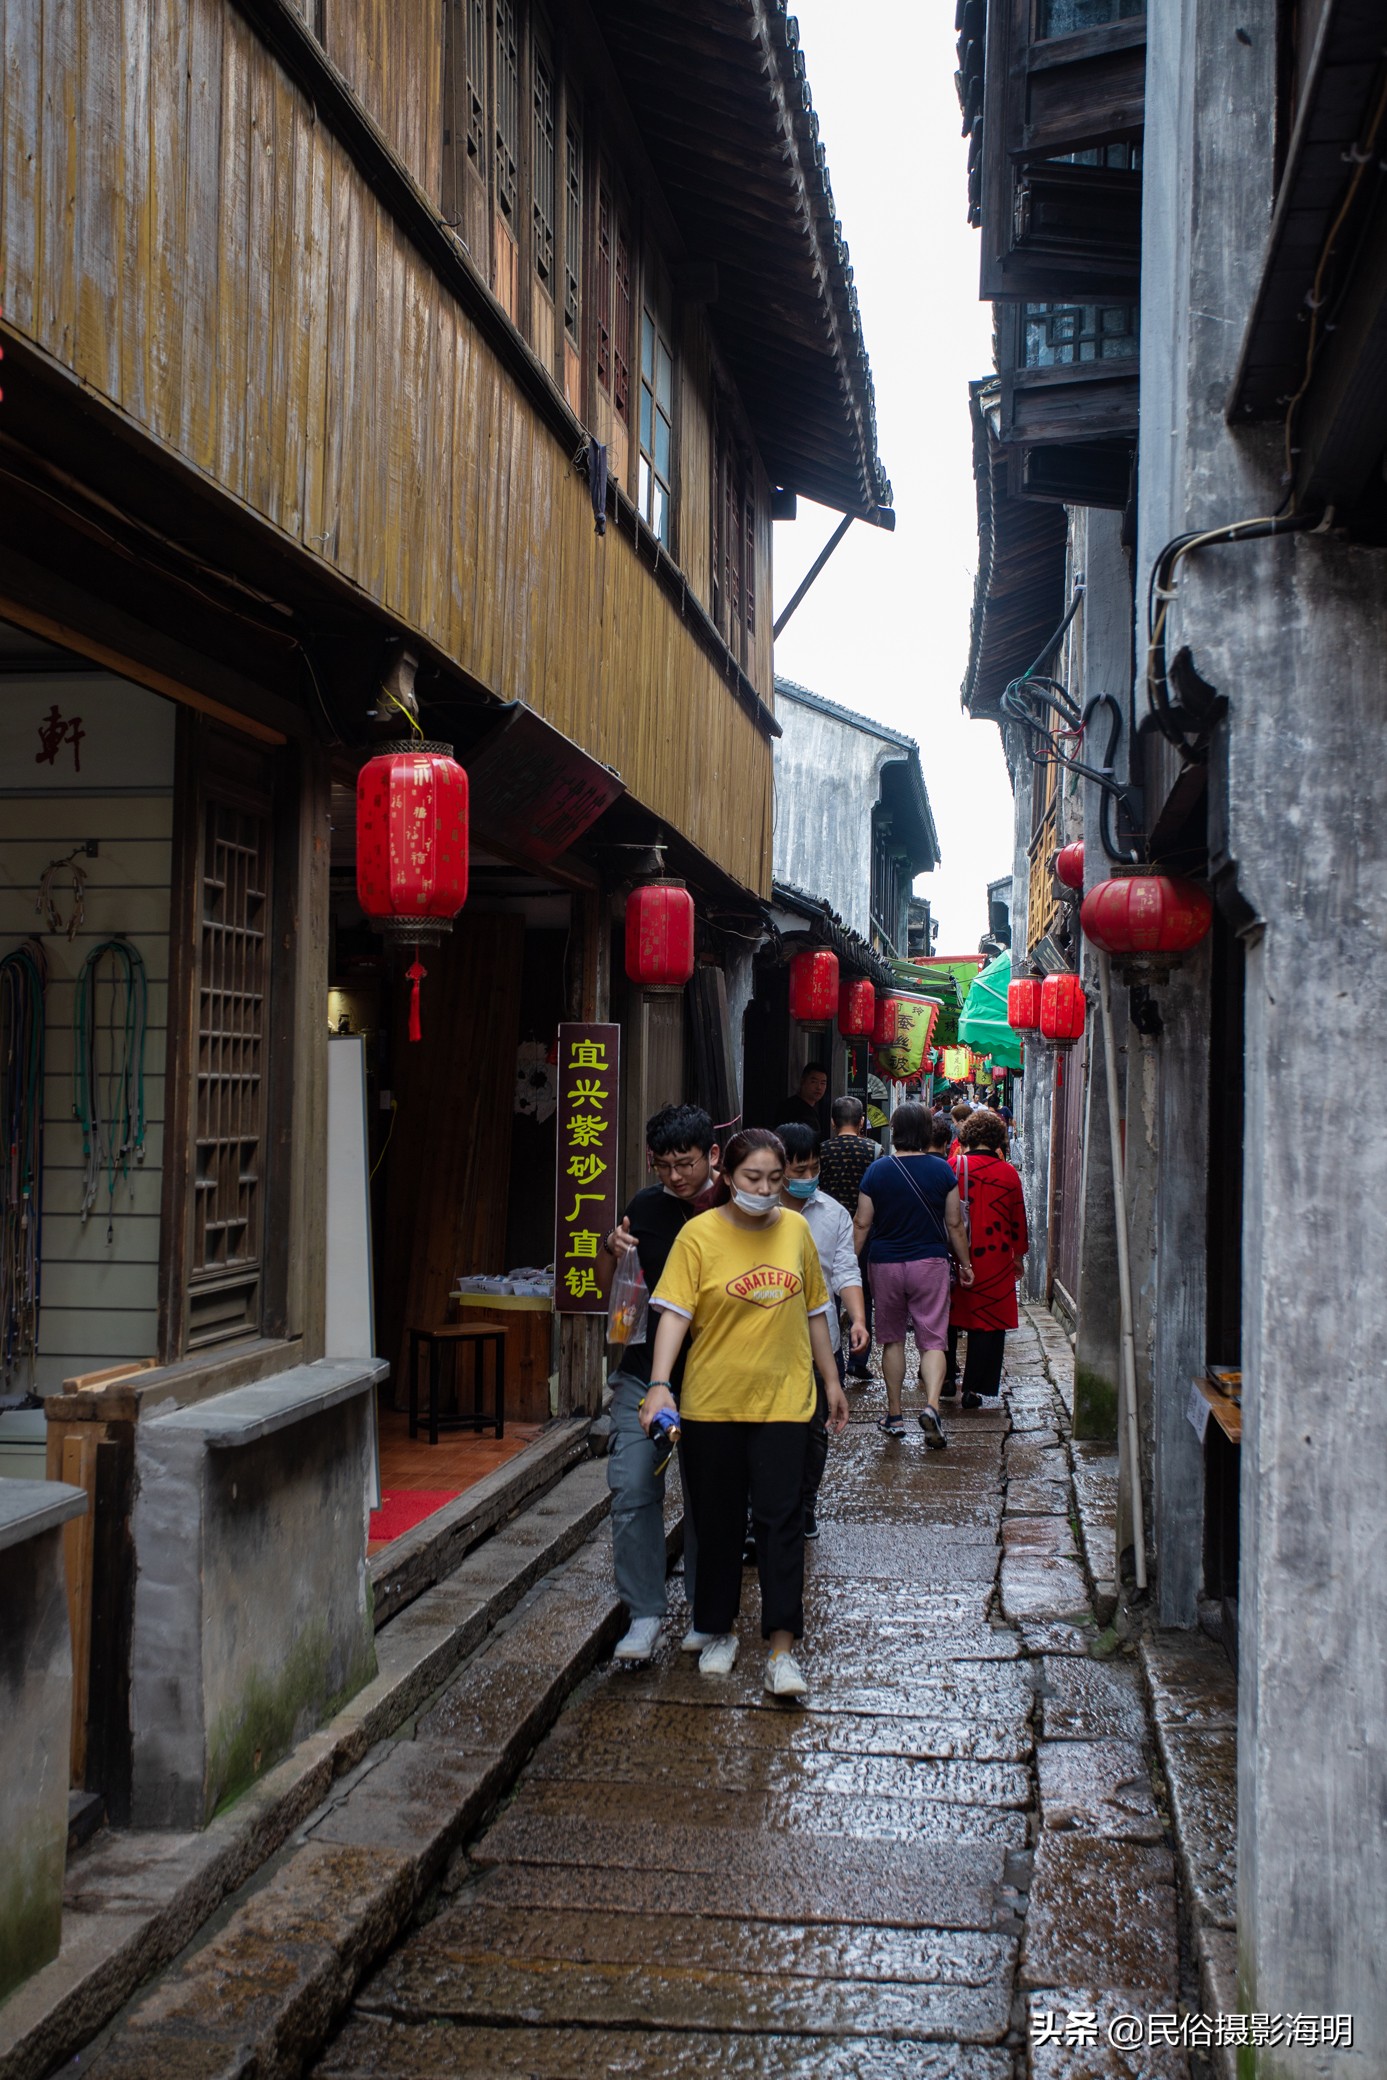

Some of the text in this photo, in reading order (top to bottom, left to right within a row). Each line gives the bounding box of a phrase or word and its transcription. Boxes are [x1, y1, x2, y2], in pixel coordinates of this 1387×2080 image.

[889, 1014, 916, 1073] 蚕丝被
[564, 1038, 609, 1299] 宜兴紫砂厂直销
[734, 1271, 799, 1296] GRATEFUL
